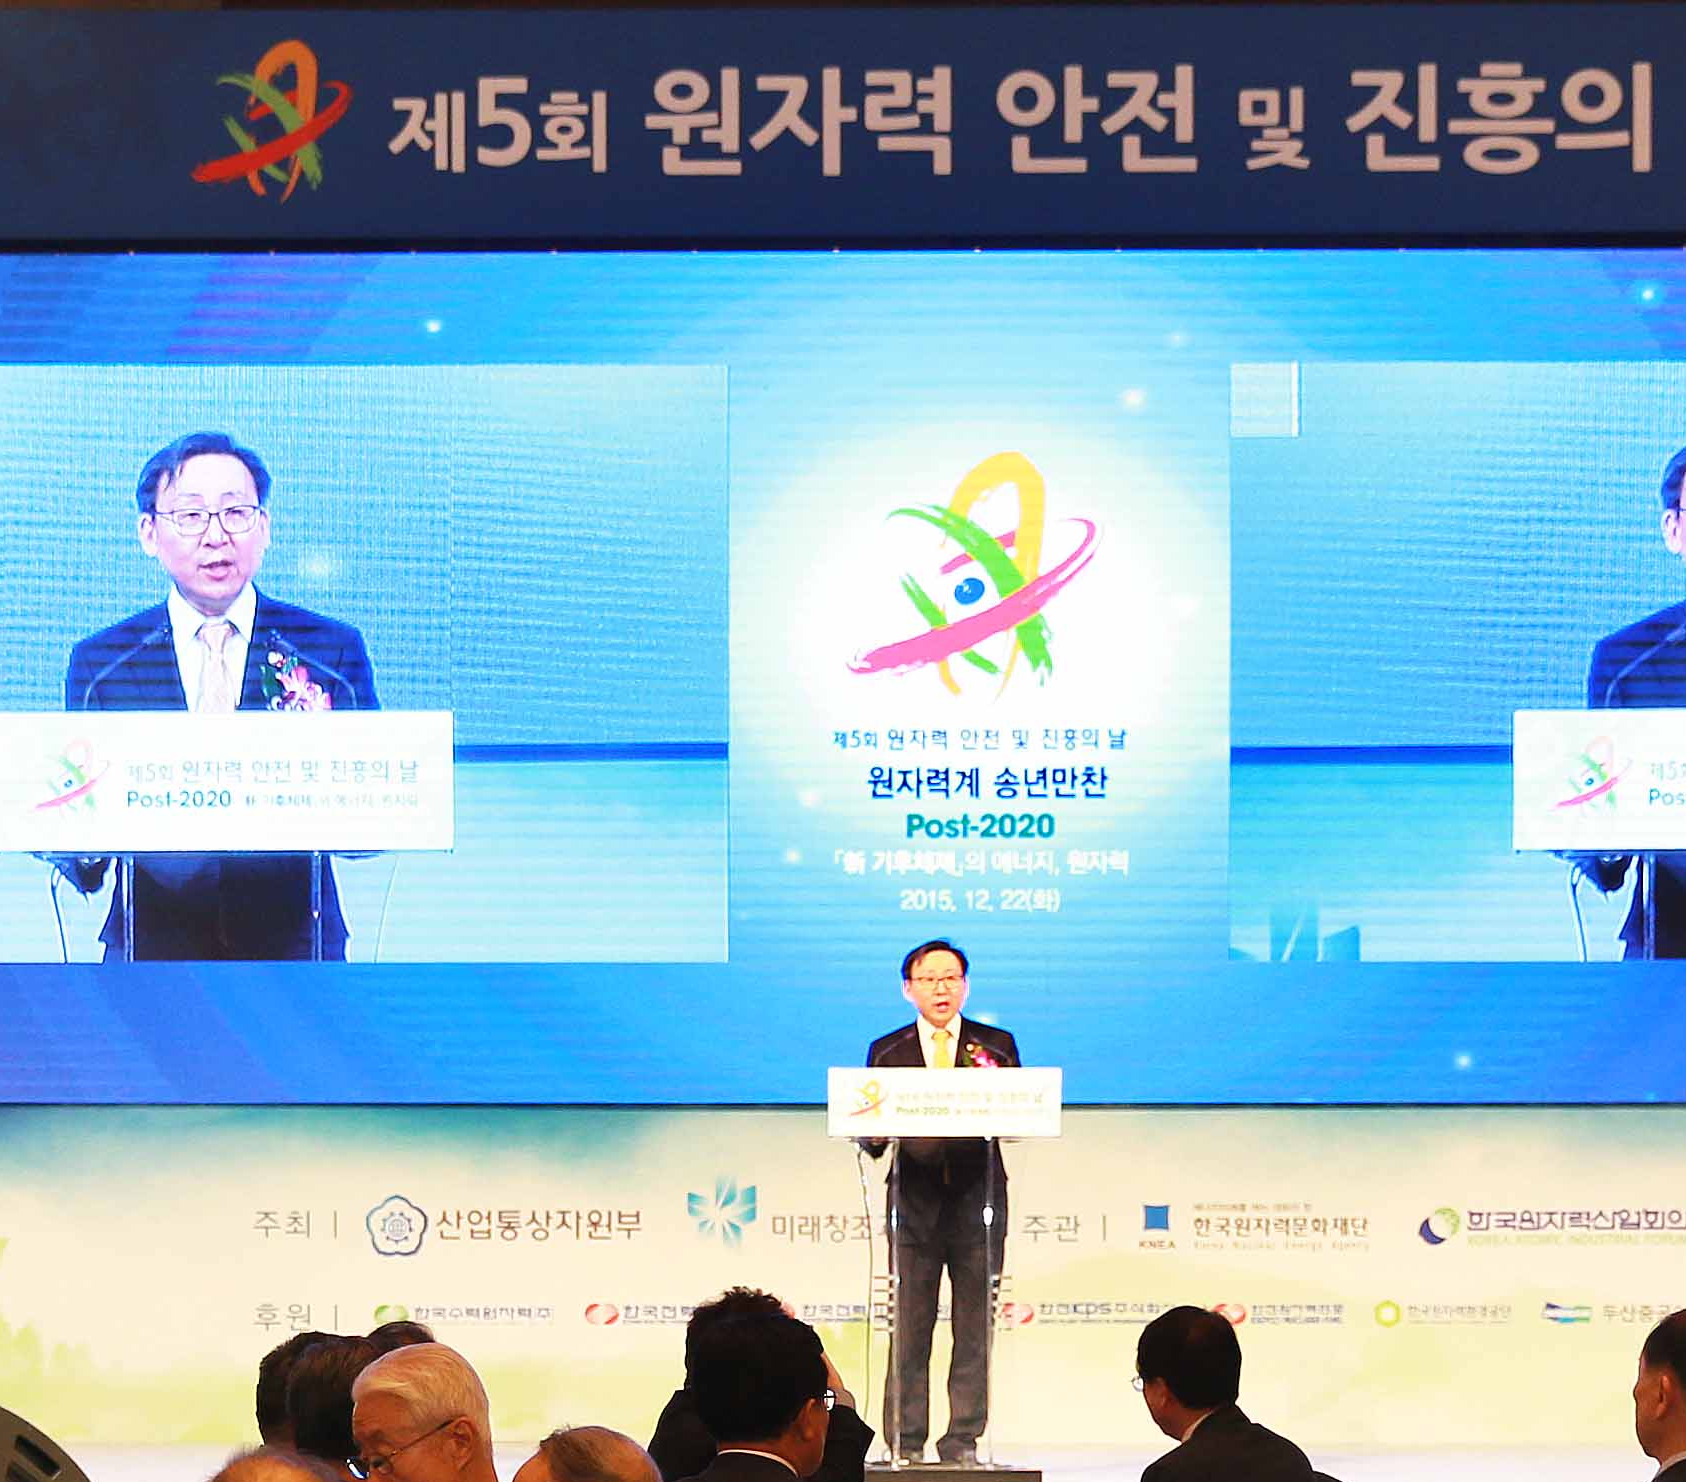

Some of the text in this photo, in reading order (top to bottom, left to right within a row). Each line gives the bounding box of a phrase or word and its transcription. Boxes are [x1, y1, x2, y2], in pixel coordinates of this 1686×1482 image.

[388, 76, 608, 174] 제5회
[644, 66, 953, 177] 원자력
[995, 64, 1198, 174] 안전
[1237, 86, 1311, 171] 및
[1345, 62, 1653, 175] 진흥의
[832, 728, 1128, 750] 제5회 원자력 안전 및 진흥의 날
[182, 760, 243, 784] 원자력
[867, 766, 1108, 800] 원자력계 송년만찬
[126, 790, 232, 808] Post-2020
[906, 812, 1056, 839] Post-2020
[899, 889, 957, 912] 2015.
[253, 1208, 888, 1243] 주최 산업통상자원부 미래창조
[1021, 1214, 1080, 1242] 주관
[1193, 1215, 1369, 1237] 한국원자력문화재단
[253, 1303, 311, 1332] 후원
